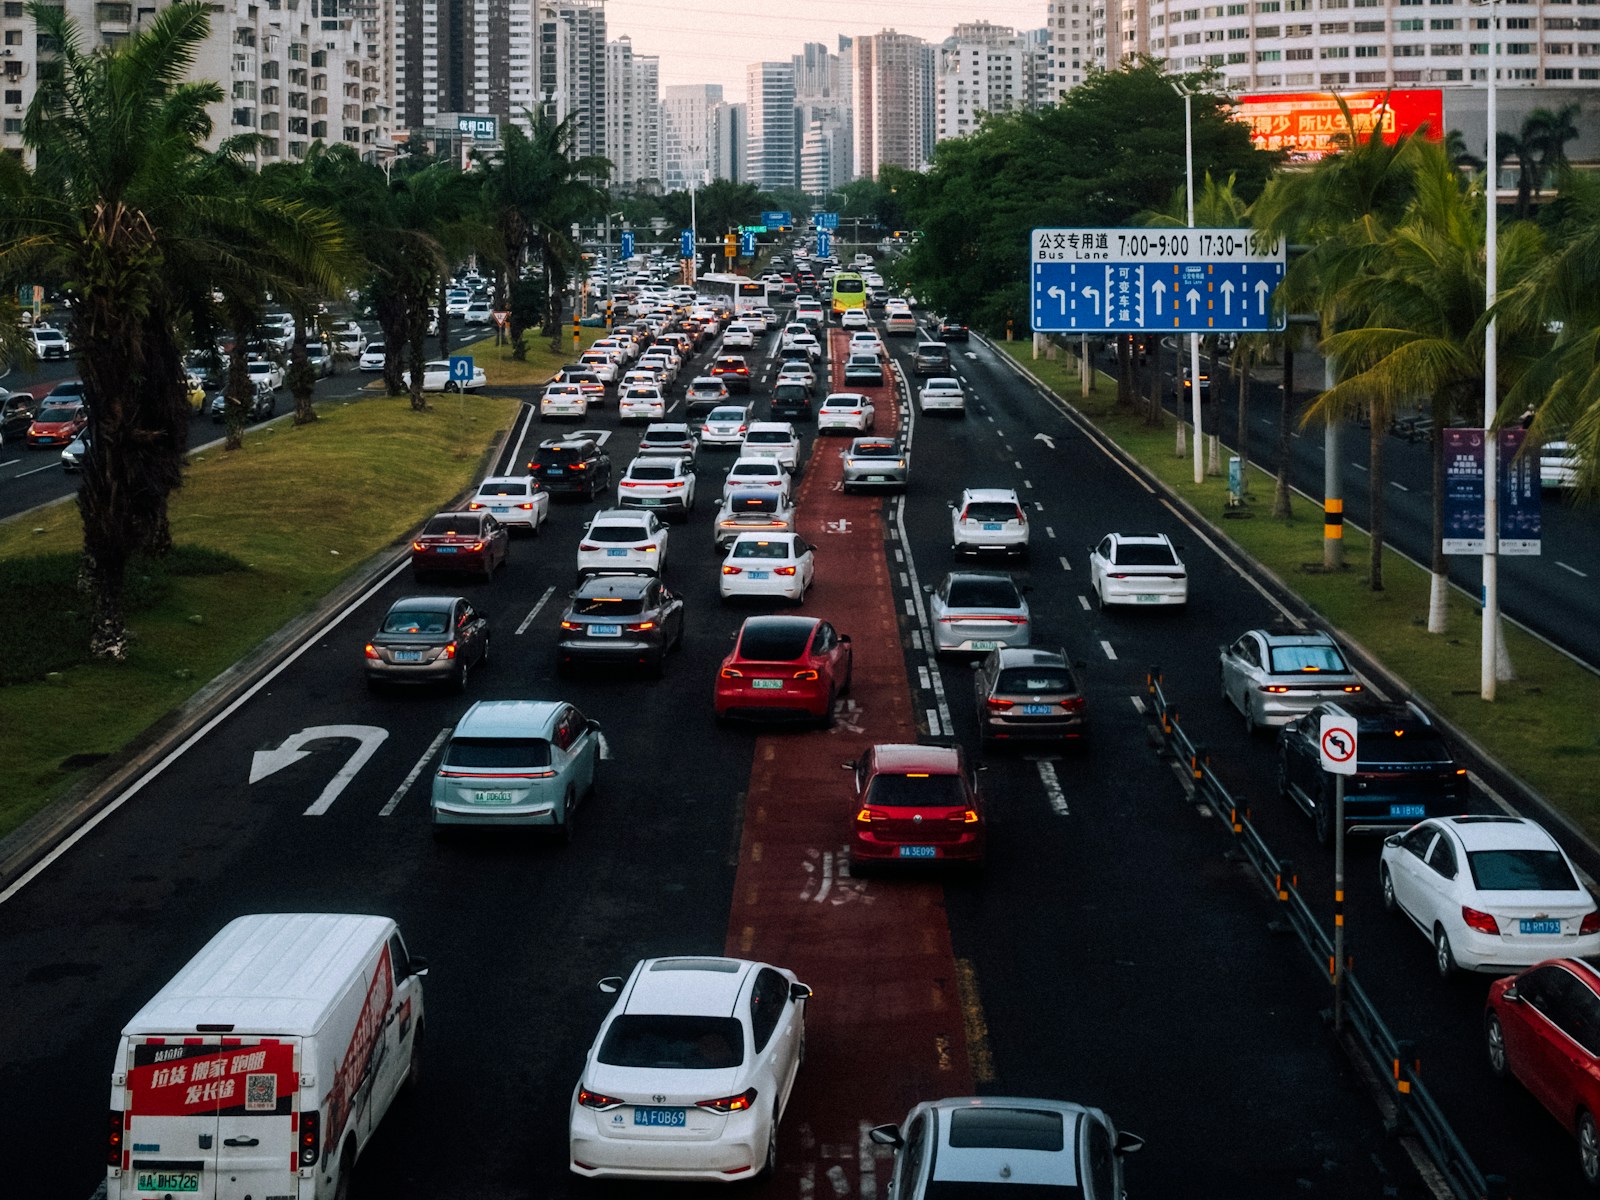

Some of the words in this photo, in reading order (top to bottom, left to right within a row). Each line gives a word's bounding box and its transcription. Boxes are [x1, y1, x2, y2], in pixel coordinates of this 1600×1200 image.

[1039, 233, 1108, 249] 公交专用道
[1118, 235, 1188, 256] 7:00-9:00
[1039, 250, 1064, 259] Bus
[1075, 250, 1108, 259] Lane
[1118, 267, 1131, 322] 可变车道
[151, 1065, 188, 1089] 拉货
[190, 1057, 228, 1082] 搬家
[230, 1051, 267, 1075] 跑腿
[184, 1078, 236, 1105] 发长途
